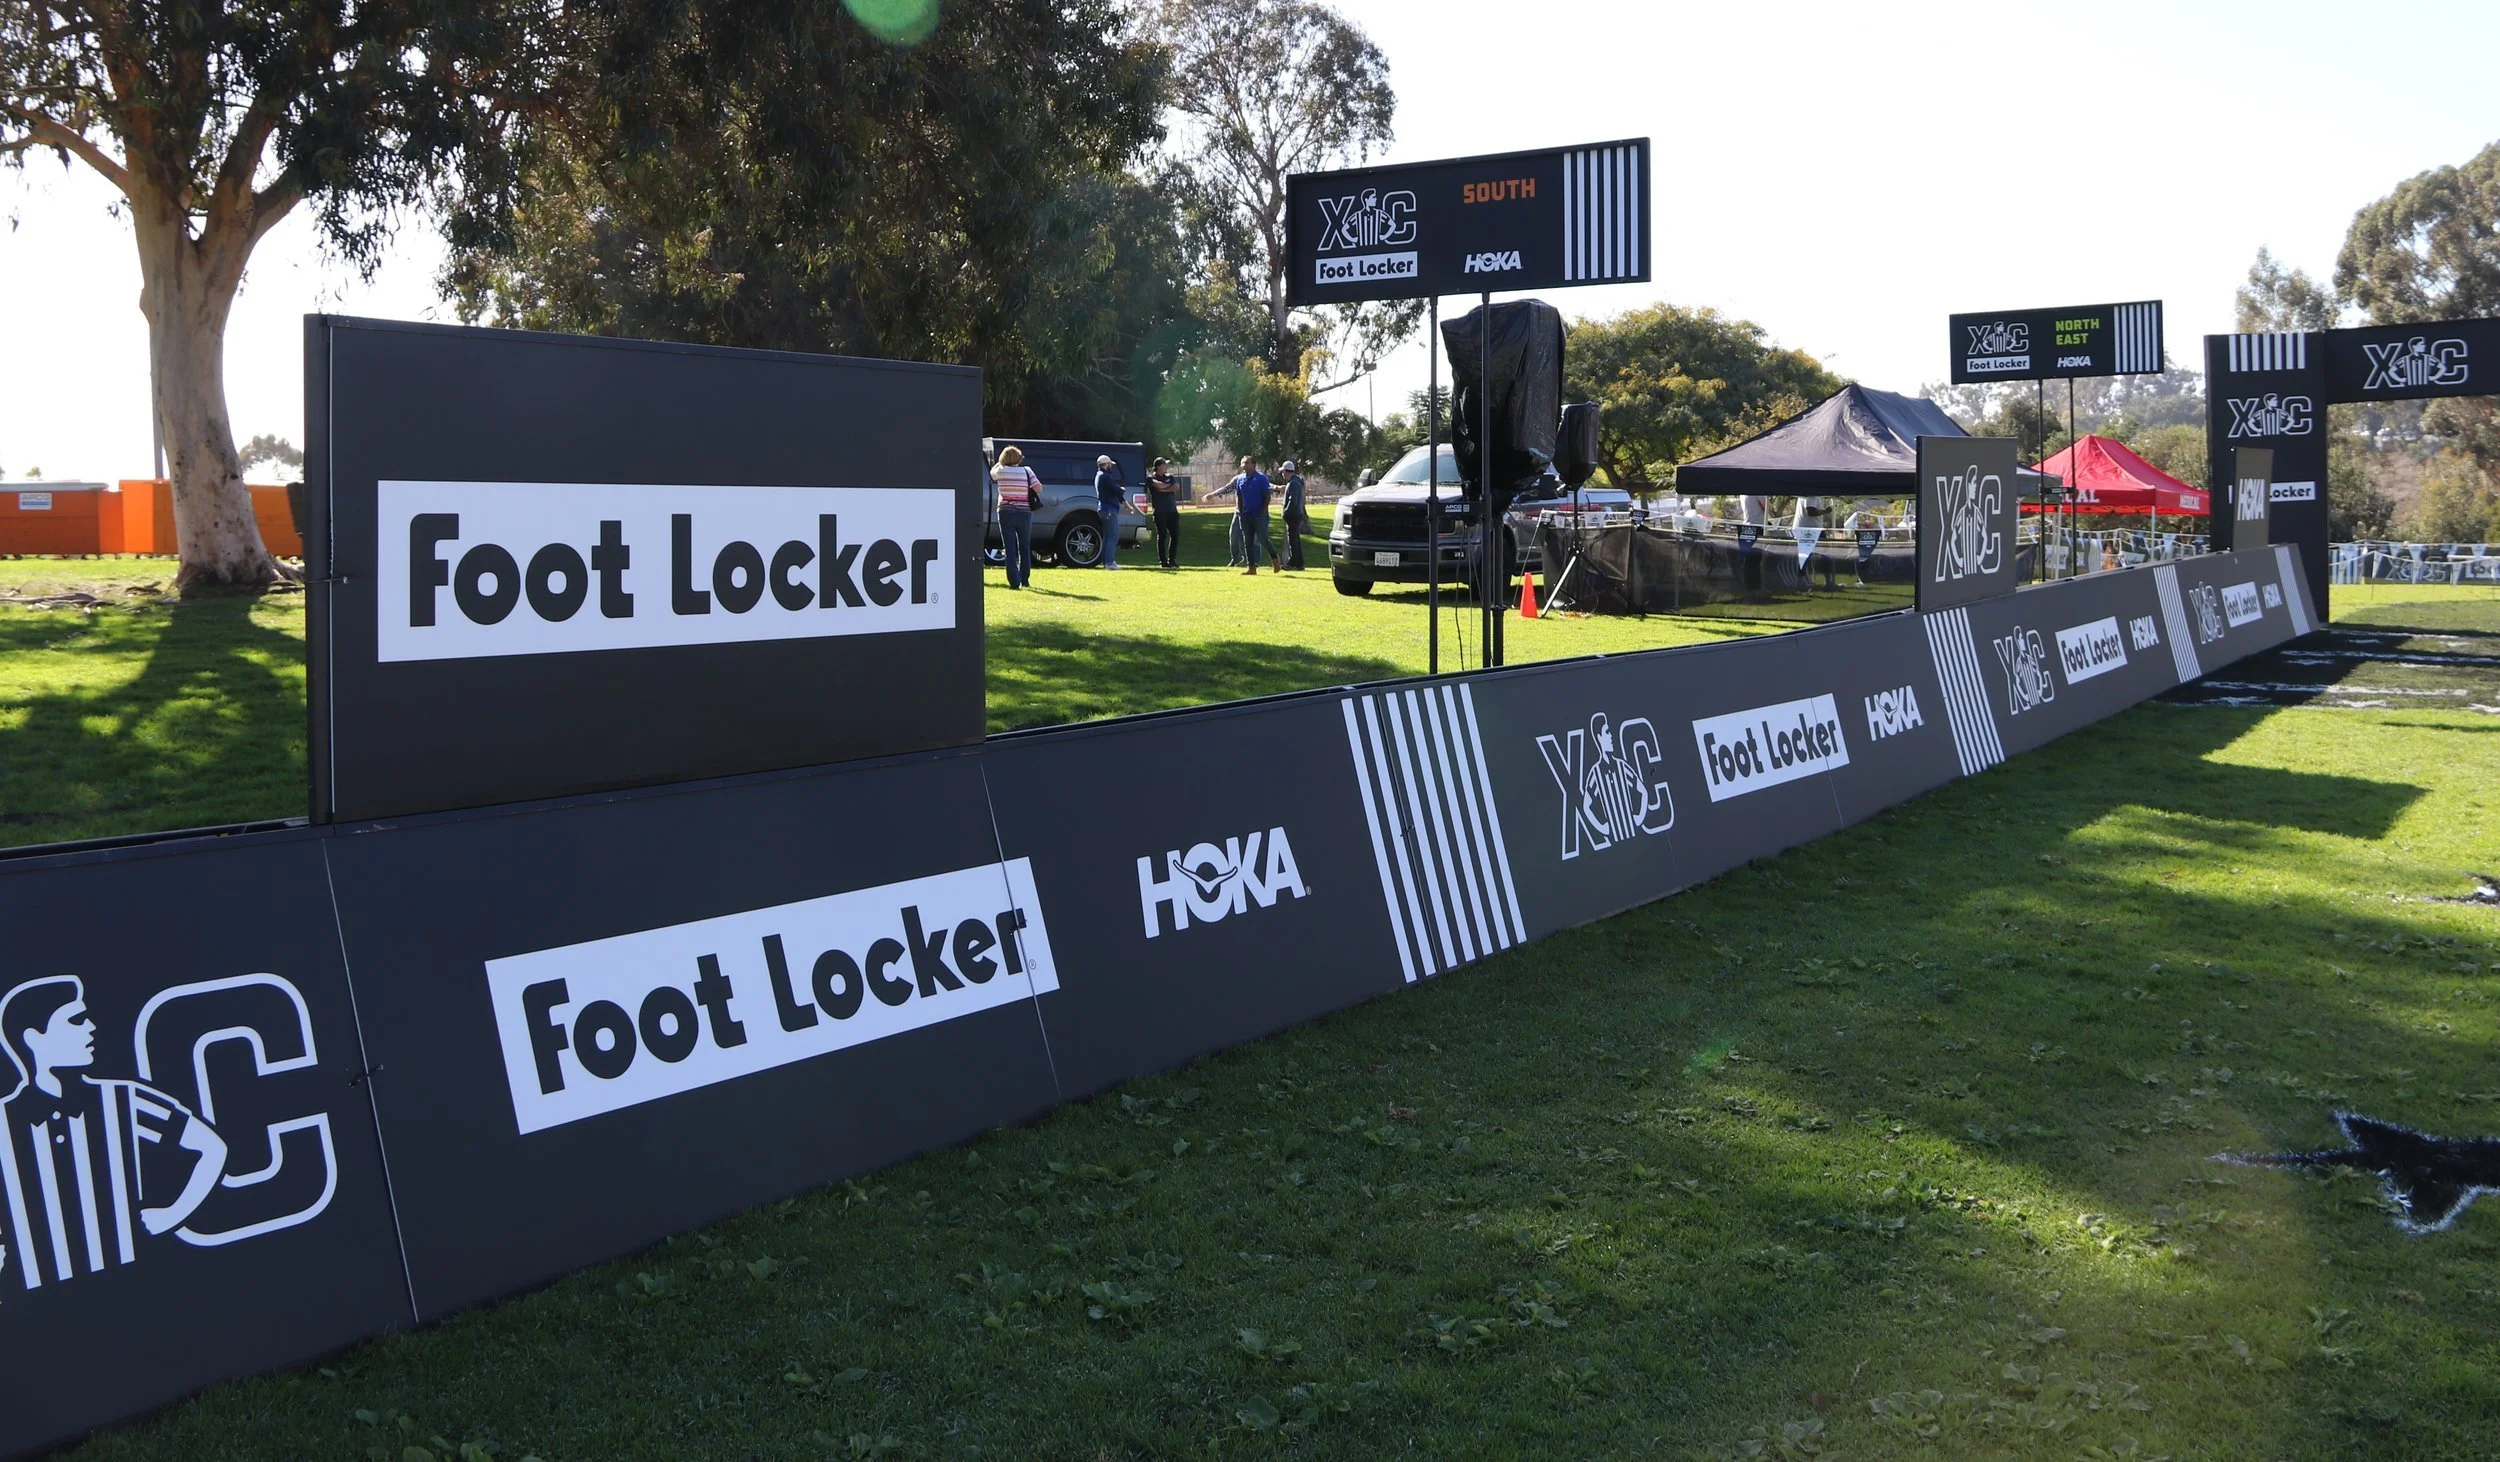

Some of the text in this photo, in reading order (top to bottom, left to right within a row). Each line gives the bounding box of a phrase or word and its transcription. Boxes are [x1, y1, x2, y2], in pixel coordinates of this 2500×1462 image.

[1464, 178, 1536, 204] SOUTH
[1320, 258, 1413, 279] Foot Locker
[1464, 251, 1521, 273] HOKA
[2055, 318, 2099, 332] NORTH
[2056, 333, 2088, 345] EAST
[1969, 359, 2028, 370] Foot Locker
[2057, 356, 2091, 368] HOKA
[410, 513, 939, 627] Foot Locker
[2129, 615, 2160, 651] HOKA
[2061, 628, 2122, 674] Foot Locker
[1864, 685, 1923, 741] HOKA
[1704, 698, 1838, 785] Foot Locker
[1136, 826, 1306, 939] HOKA
[522, 905, 1027, 1095] Foot Locker
